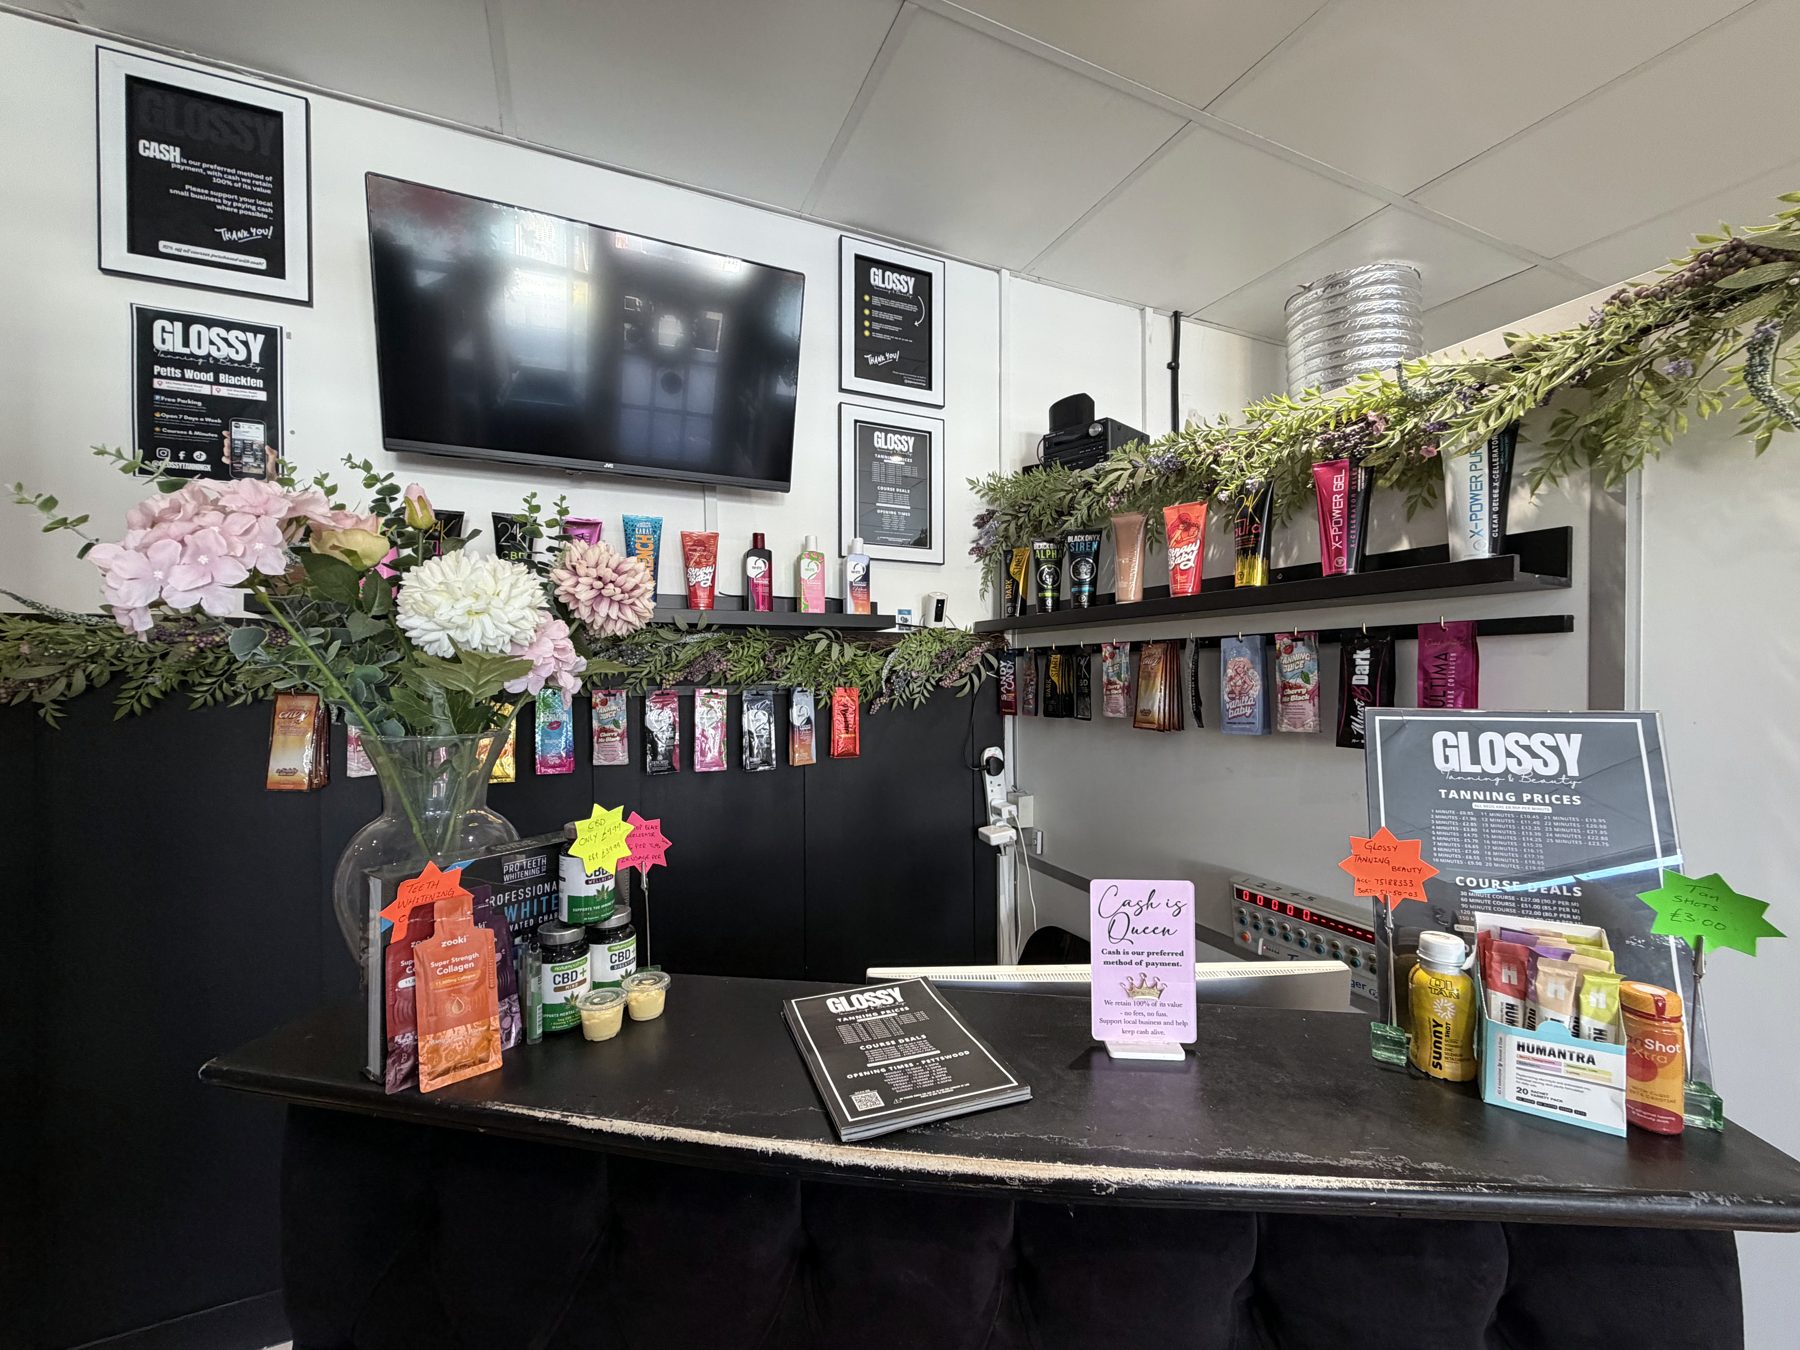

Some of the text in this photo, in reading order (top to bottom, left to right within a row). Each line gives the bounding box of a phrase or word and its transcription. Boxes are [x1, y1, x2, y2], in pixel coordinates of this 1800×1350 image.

[138, 138, 181, 164] CASH
[202, 163, 236, 174] preferred
[237, 170, 264, 180] method
[171, 163, 206, 175] payment,
[252, 179, 273, 188] retain
[212, 178, 232, 186] 100%
[170, 188, 189, 197] small
[190, 192, 222, 203] business
[233, 201, 256, 211] paying
[257, 206, 273, 214] cash
[185, 185, 209, 194] Please
[210, 190, 238, 200] support
[256, 198, 273, 207] local
[216, 204, 268, 219] where possible
[214, 226, 273, 242] THANK YOU!
[870, 267, 915, 294] GLOSSY
[153, 319, 265, 364] GLOSSY
[864, 354, 885, 366] THANK
[154, 365, 214, 382] Petts Wood
[219, 373, 264, 388] Blackfen
[177, 398, 202, 406] Parking
[873, 431, 915, 452] GLOSSY
[1332, 469, 1345, 549] X-POWER GEL
[1469, 474, 1483, 539] X-POWER
[1070, 541, 1098, 552] SIREN
[1168, 539, 1200, 557] Straw
[1168, 550, 1198, 570] Baby
[1005, 578, 1013, 599] DARK
[1280, 652, 1311, 664] TANNING
[1283, 661, 1305, 672] JUICE
[1006, 660, 1014, 689] CANDY
[1448, 653, 1456, 686] COLLAGEN
[1430, 652, 1448, 708] ULTIMA
[1350, 649, 1370, 735] Must Dark
[1226, 696, 1256, 709] vanilla
[1228, 706, 1253, 719] baby
[1432, 731, 1582, 776] GLOSSY
[1440, 768, 1582, 789] Tanning & Beauty
[1438, 789, 1582, 805] TANNING PRICES
[588, 818, 606, 830] CBD
[579, 833, 597, 846] ONLY
[1364, 840, 1398, 853] GLOSSY
[503, 857, 547, 874] PRO TEETH
[1354, 854, 1390, 865] TANNING
[504, 865, 540, 882] WHITENING
[1455, 876, 1582, 896] COURSE DEALS
[1685, 884, 1719, 902] Tan
[1098, 884, 1187, 918] Cash is
[1672, 895, 1719, 912] SHOTS
[1108, 912, 1178, 945] Queen
[441, 936, 467, 948] zooki
[431, 953, 479, 968] Super Strength
[610, 949, 631, 964] CBD
[436, 961, 475, 975] Collagen
[553, 971, 578, 986] CBD
[826, 987, 904, 1013] GLOSSY
[837, 1012, 878, 1022] TANNING
[881, 1006, 910, 1016] PRICES
[859, 1034, 927, 1050] COURSE DEALS
[1432, 1019, 1443, 1070] sunny
[1516, 1041, 1596, 1065] HUMANTRA
[1632, 1046, 1667, 1064] Xtra
[847, 1068, 886, 1079] OPENING
[889, 1062, 914, 1072] TIMES
[921, 1051, 970, 1064] PETTSWOOD
[1516, 1086, 1528, 1095] 20
